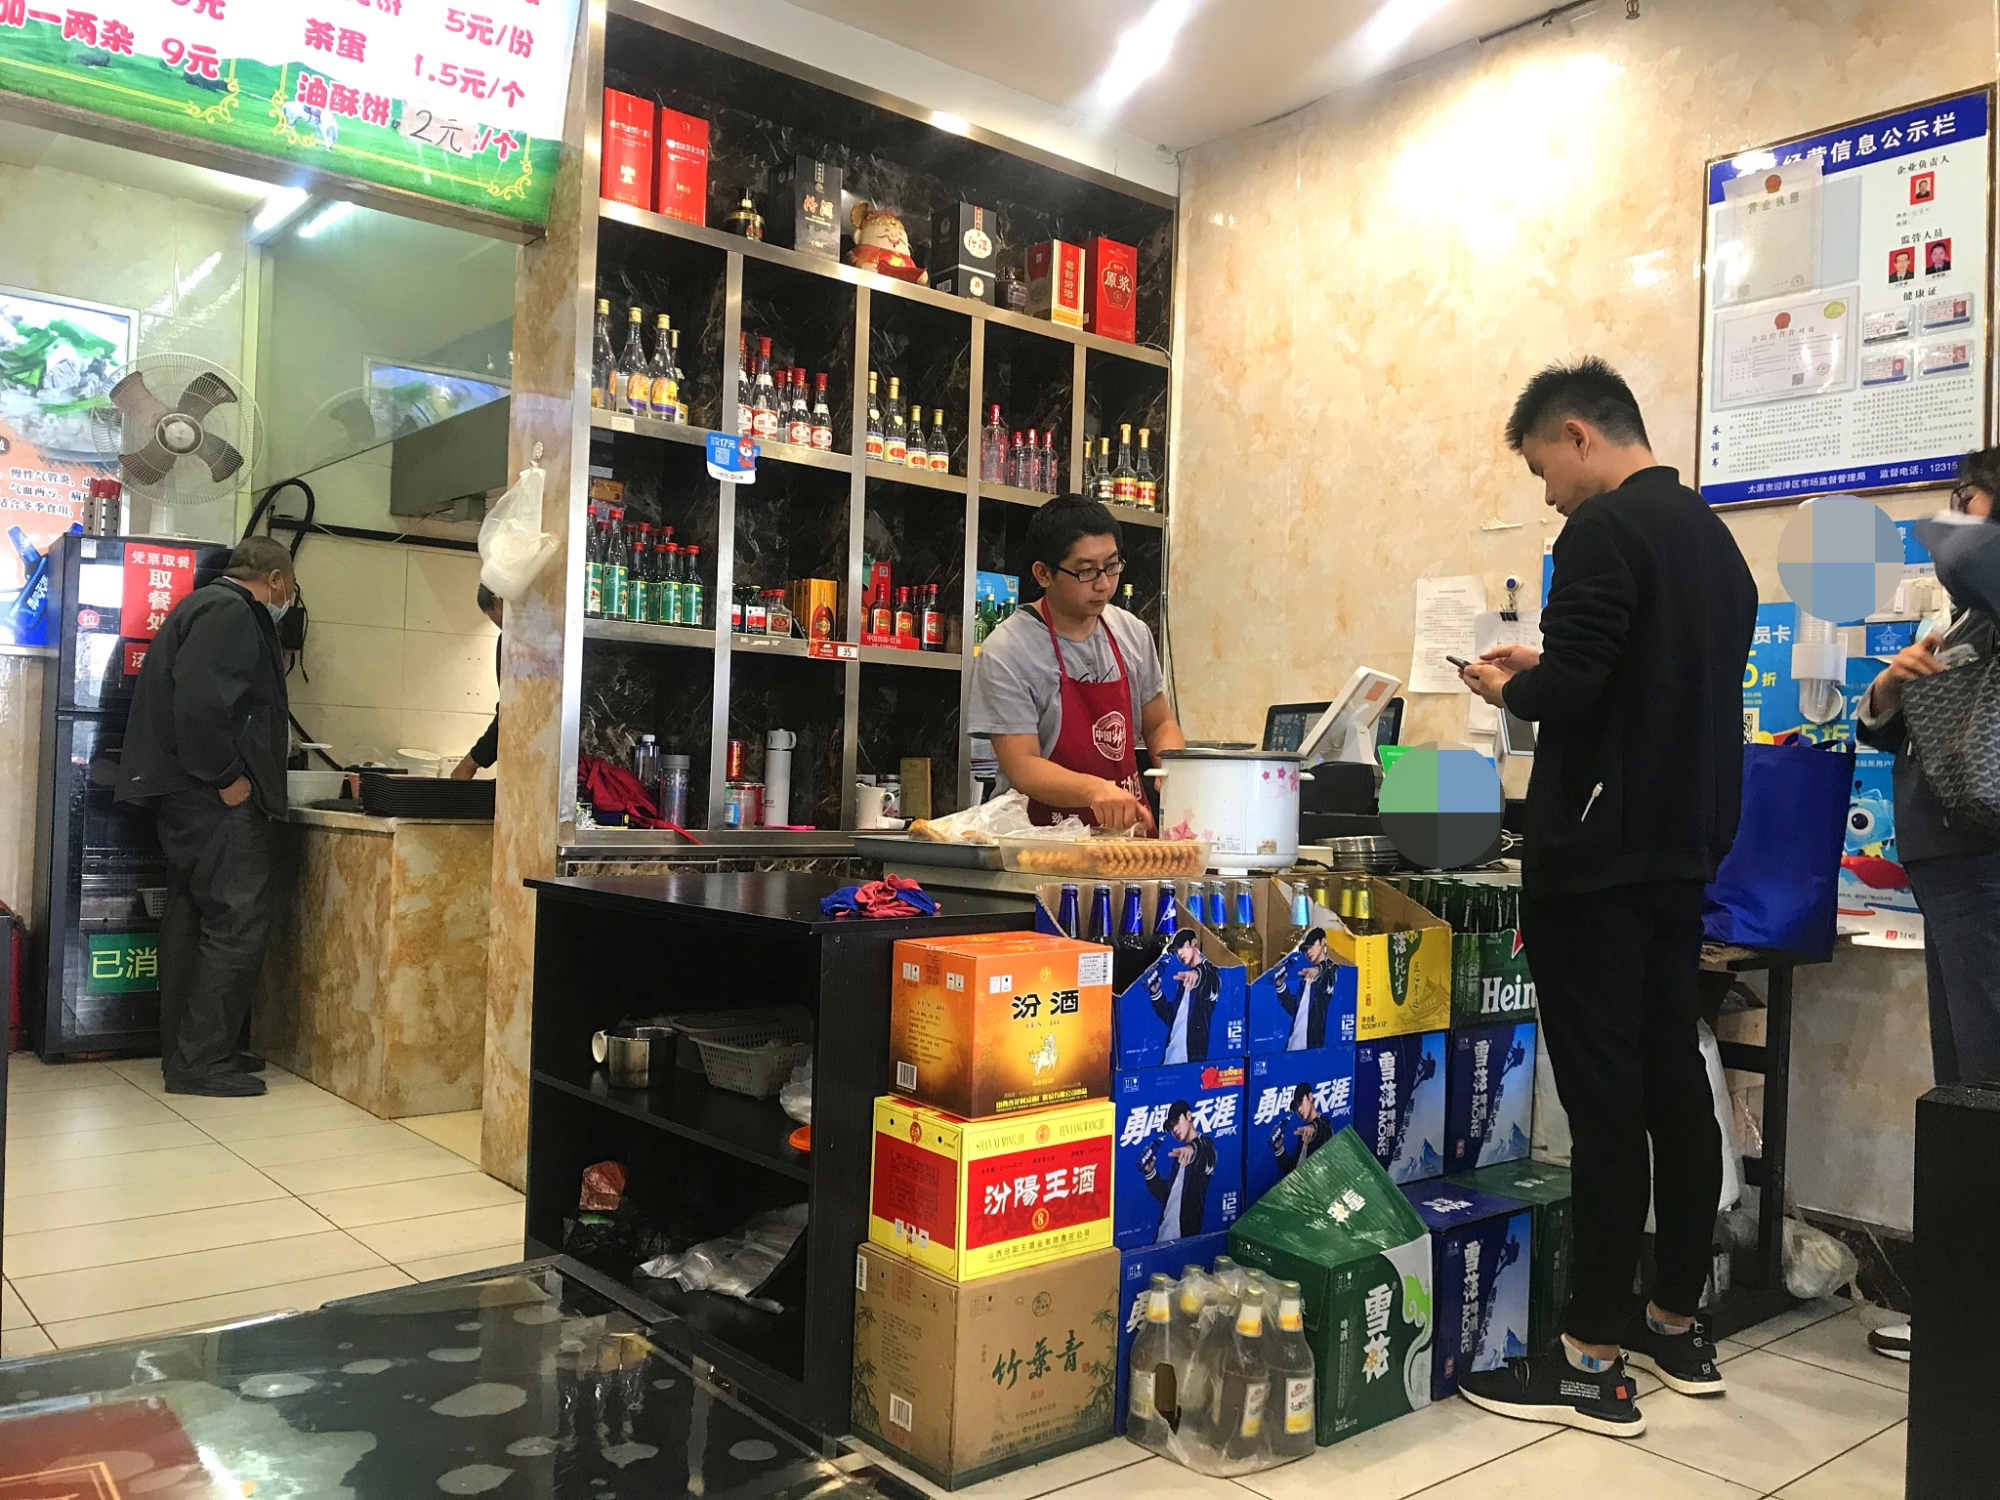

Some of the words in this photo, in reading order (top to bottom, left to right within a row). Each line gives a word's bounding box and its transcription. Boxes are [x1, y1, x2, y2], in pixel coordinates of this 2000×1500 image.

[304, 18, 367, 63] 茶蛋
[444, 7, 534, 58] 5元/份
[161, 37, 220, 79] 9元
[414, 53, 525, 108] 1.5元/个
[298, 73, 391, 126] 油酥饼
[1897, 155, 1950, 175] 企业负责人
[1748, 192, 1800, 214] 营业执照
[1900, 228, 1943, 244] 监管人员
[1104, 271, 1131, 293] 原浆
[1903, 286, 1937, 301] 健康证
[1751, 324, 1817, 344] 食品经营许可证
[1747, 471, 1866, 494] 太原市迎泽区市场监督管理局
[1929, 460, 1958, 473] 12315
[131, 550, 190, 569] 凭票取餐
[82, 613, 97, 626] 拉
[843, 647, 851, 656] 35
[1010, 989, 1079, 1020] 汾酒
[1228, 1026, 1242, 1038] 12
[1341, 1019, 1355, 1031] 12
[1473, 1039, 1490, 1093] 雪花
[1378, 1051, 1397, 1110] 雪花
[983, 1163, 1098, 1216] 汾陽王酒
[1222, 1197, 1236, 1210] 12
[1036, 1209, 1044, 1226] 8
[987, 1229, 1091, 1260] 山西汾阳王酒业有限责任公司
[1463, 1240, 1481, 1302] 雪花
[1361, 1282, 1393, 1384] 雪花
